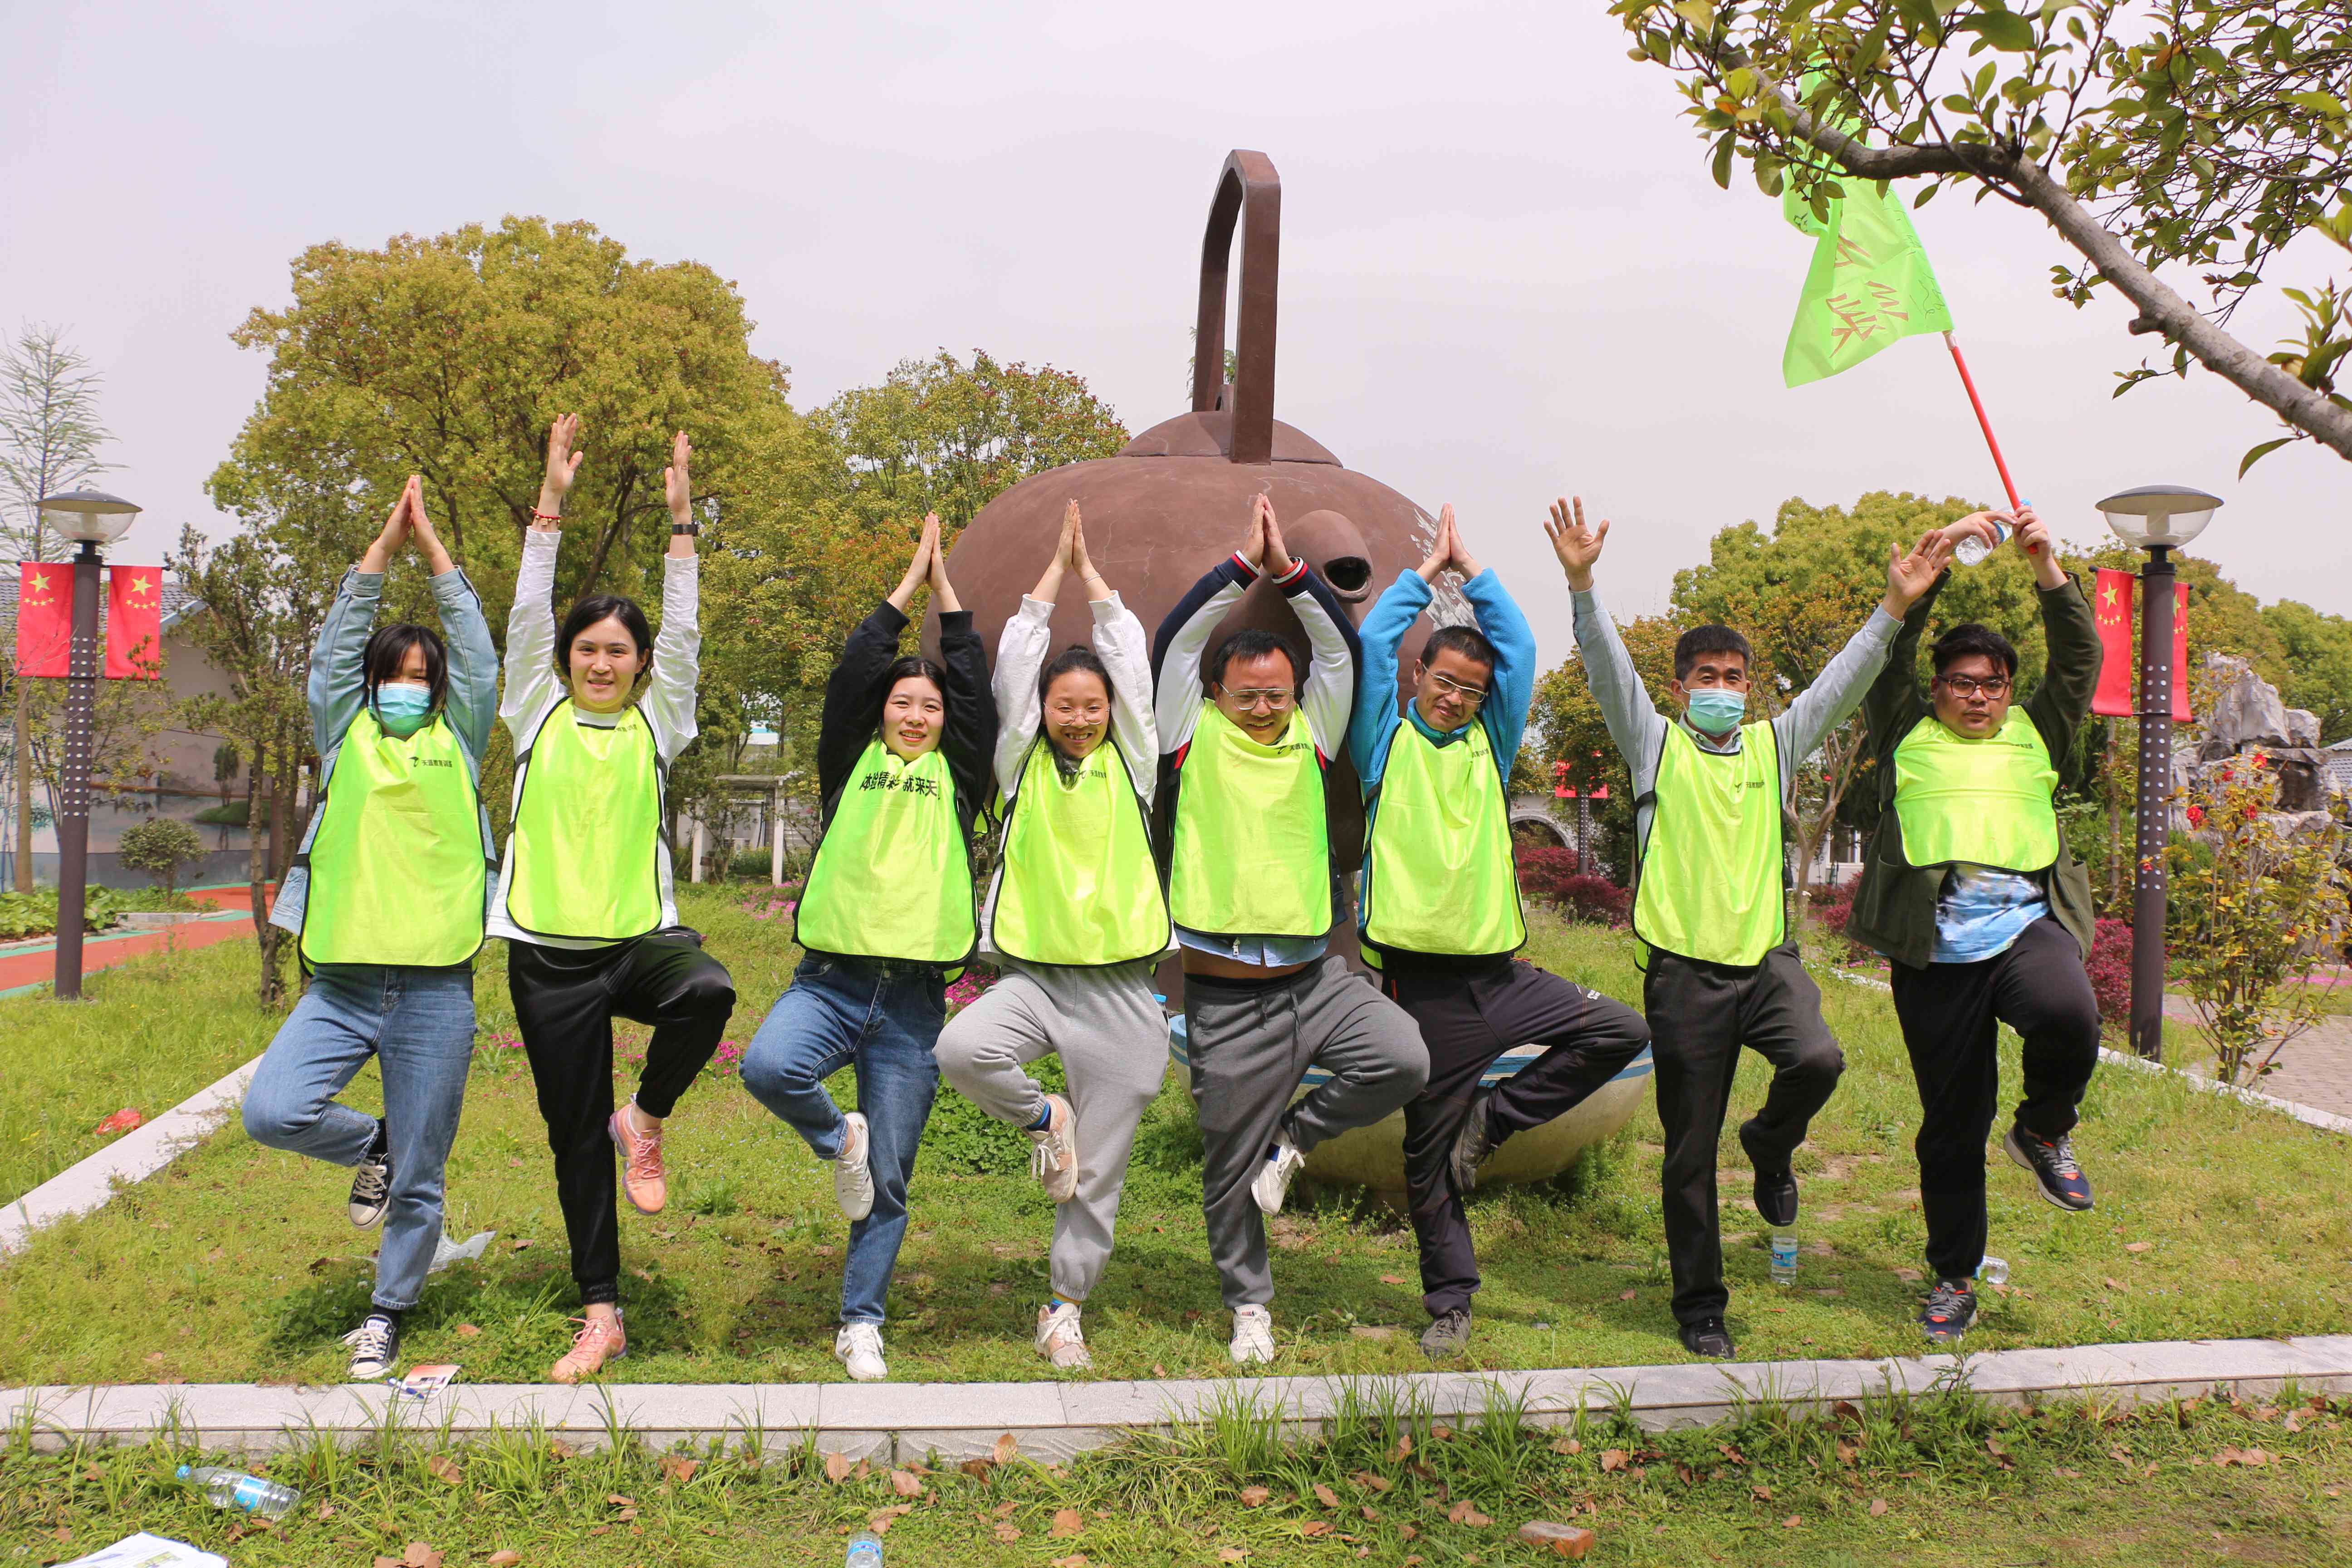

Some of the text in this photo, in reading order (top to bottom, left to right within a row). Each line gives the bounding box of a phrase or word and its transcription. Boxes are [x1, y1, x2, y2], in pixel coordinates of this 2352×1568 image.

[859, 770, 941, 800] 体验精彩 就来天
